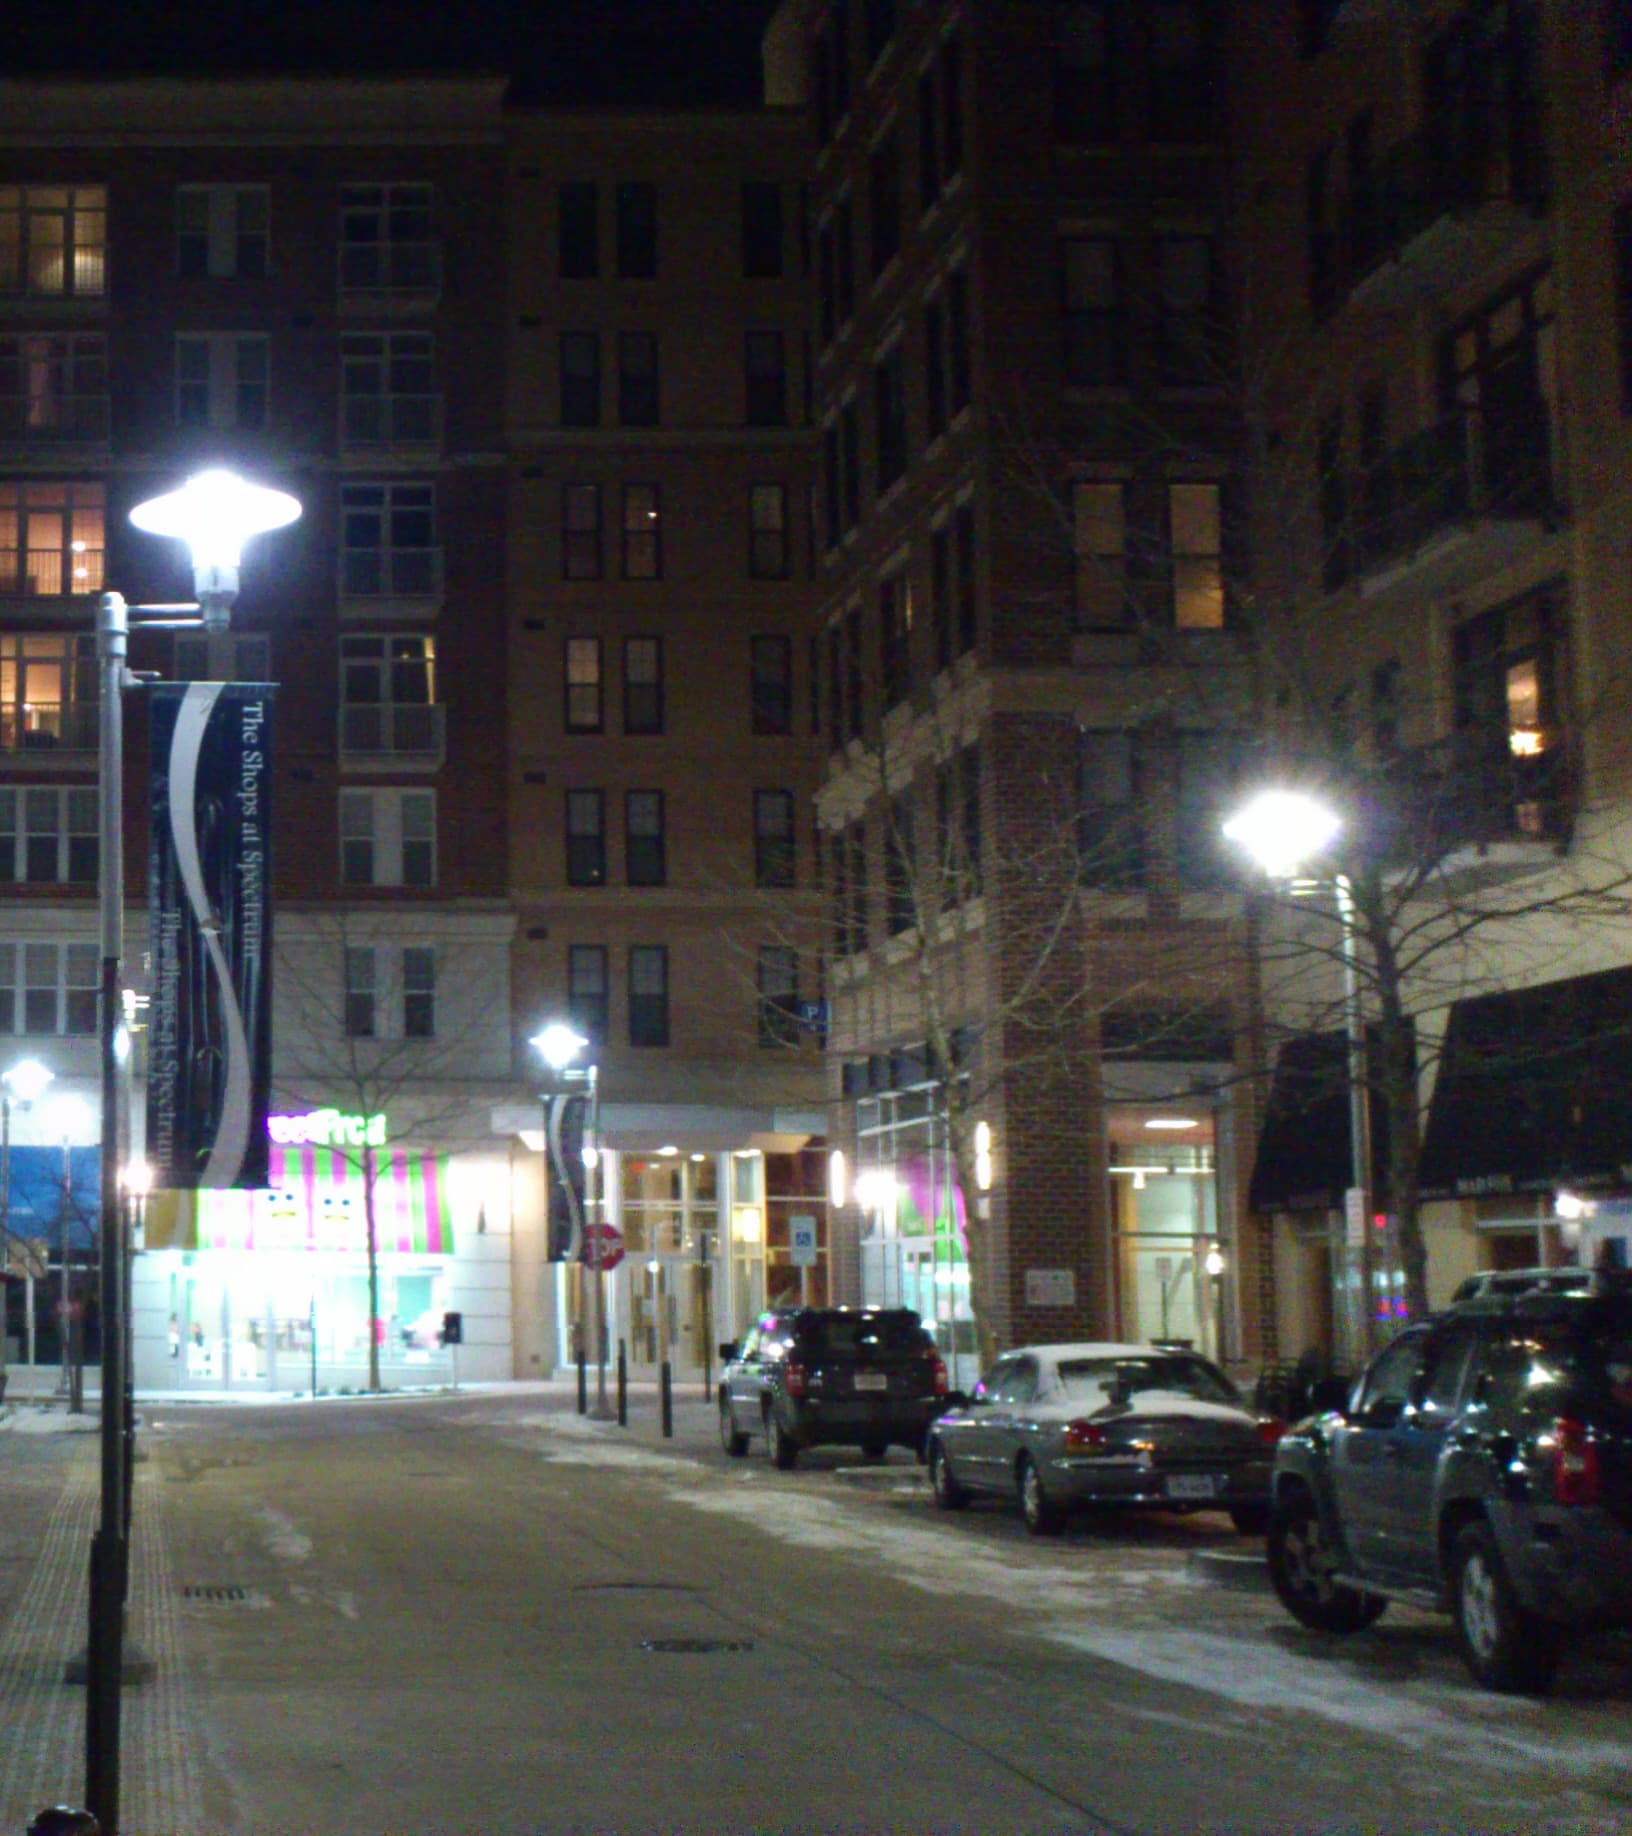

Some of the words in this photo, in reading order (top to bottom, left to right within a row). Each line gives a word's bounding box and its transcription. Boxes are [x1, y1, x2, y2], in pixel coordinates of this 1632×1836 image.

[242, 701, 264, 744] The
[236, 750, 264, 816] Shops
[242, 822, 263, 842] at
[235, 851, 264, 959] Spectrum
